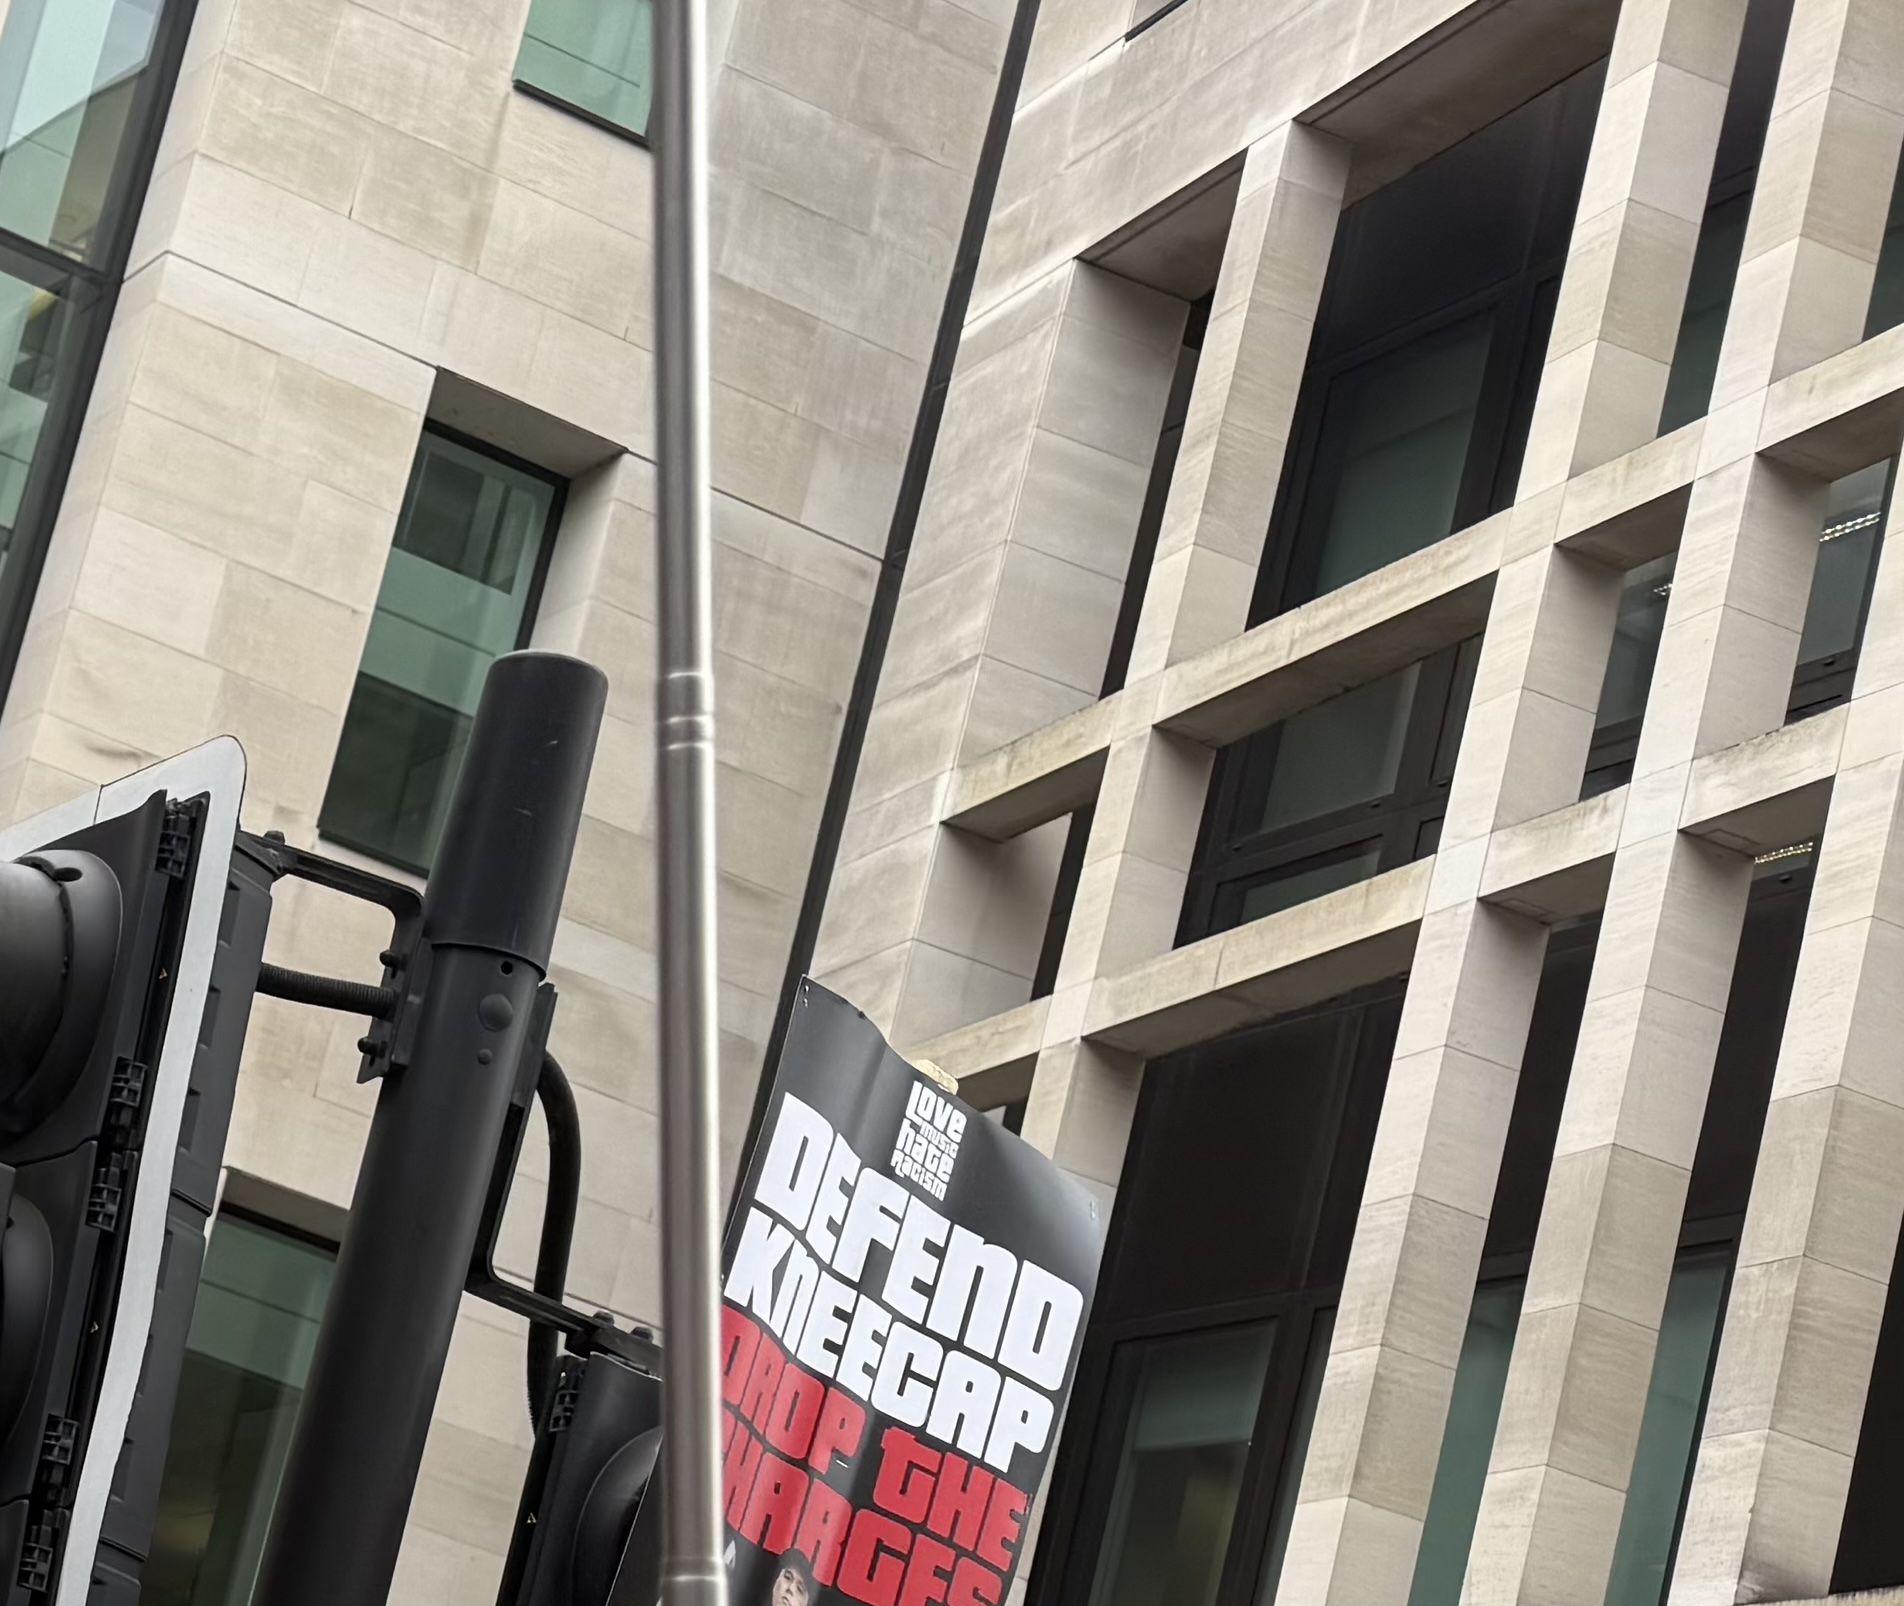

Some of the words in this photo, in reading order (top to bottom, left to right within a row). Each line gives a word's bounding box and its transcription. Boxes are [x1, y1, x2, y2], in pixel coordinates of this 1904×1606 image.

[905, 1080, 967, 1143] Love
[896, 1118, 954, 1183] hate
[721, 1304, 866, 1475] DROP
